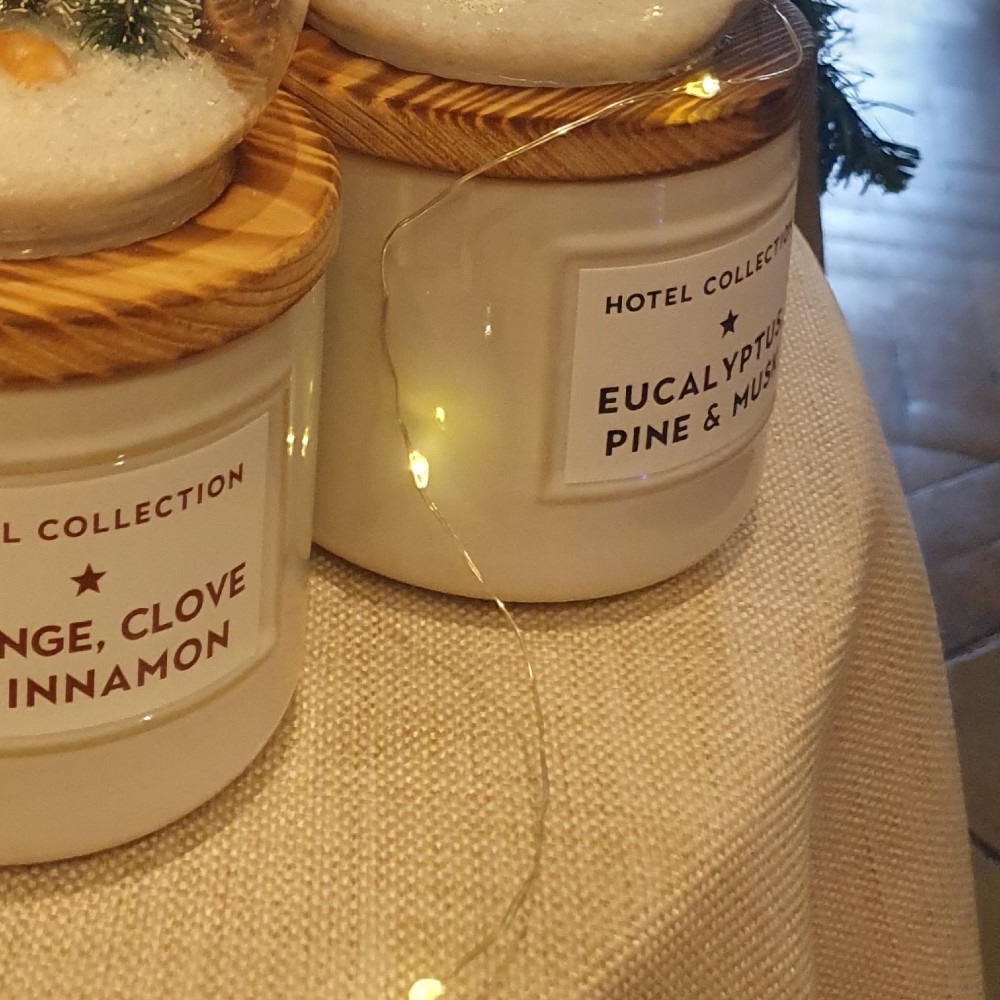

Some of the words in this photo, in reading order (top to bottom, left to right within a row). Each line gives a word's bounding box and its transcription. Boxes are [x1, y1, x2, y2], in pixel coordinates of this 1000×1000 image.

[605, 284, 693, 315] HOTEL
[598, 307, 784, 415] EUCALYPTUS
[605, 413, 690, 456] PINE
[703, 402, 721, 432] &
[37, 462, 243, 541] COLLECTION
[120, 561, 246, 641] CLOVE
